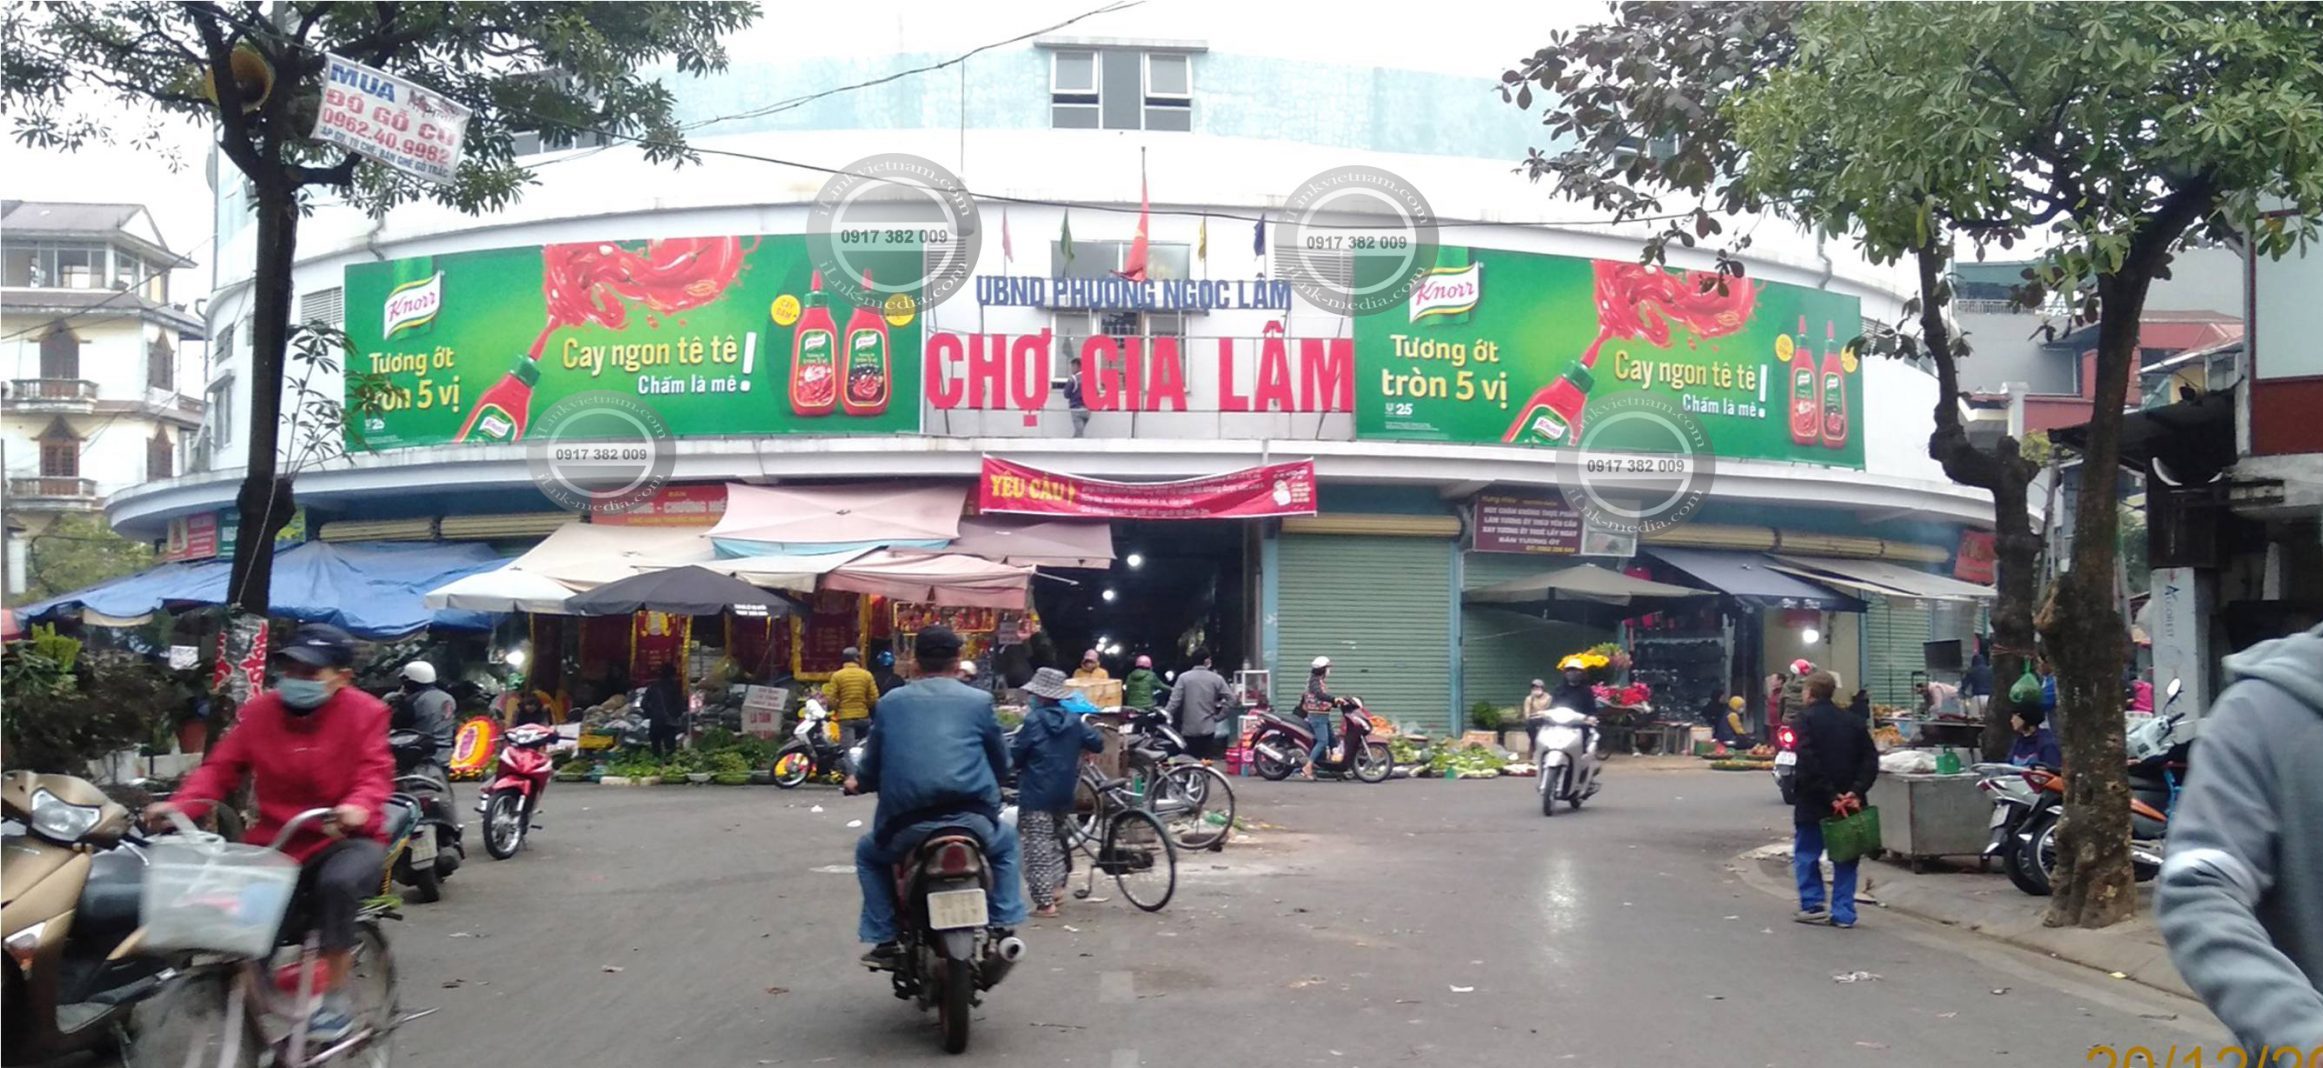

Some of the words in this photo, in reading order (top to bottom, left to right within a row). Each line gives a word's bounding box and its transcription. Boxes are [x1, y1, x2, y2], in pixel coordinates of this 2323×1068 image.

[330, 63, 395, 103] MUA
[388, 292, 435, 322] Knorr
[976, 275, 1044, 306] UBND
[1163, 279, 1229, 316] NGỌC
[1238, 272, 1292, 311] LÂM
[1416, 281, 1475, 306] Knorr
[369, 352, 427, 377] Tương
[432, 345, 455, 369] ớt
[563, 337, 606, 377] Cay
[611, 343, 670, 372] ngon
[677, 336, 703, 364] tê
[710, 335, 738, 363] tê
[1390, 334, 1466, 368] Tương
[1472, 339, 1500, 363] ớt
[638, 374, 685, 395] Chấm
[691, 374, 706, 393] là
[711, 375, 737, 392] mê
[925, 327, 1051, 428] CHỢ
[1081, 334, 1188, 412] GIA
[1219, 320, 1353, 413] LÂM
[1615, 350, 1654, 389] Cay
[1659, 362, 1707, 390] ngon
[1712, 361, 1732, 389] tê
[1737, 363, 1756, 390] tê
[417, 380, 433, 409] 5
[438, 375, 459, 413] vị
[1381, 368, 1448, 398] tròn
[1455, 371, 1475, 401] 5
[1481, 372, 1508, 409] vị
[1682, 393, 1719, 414] Chấm
[1723, 397, 1735, 415] là
[1738, 401, 1756, 417] mê
[1396, 403, 1413, 415] 25
[990, 469, 1025, 498] YÊU
